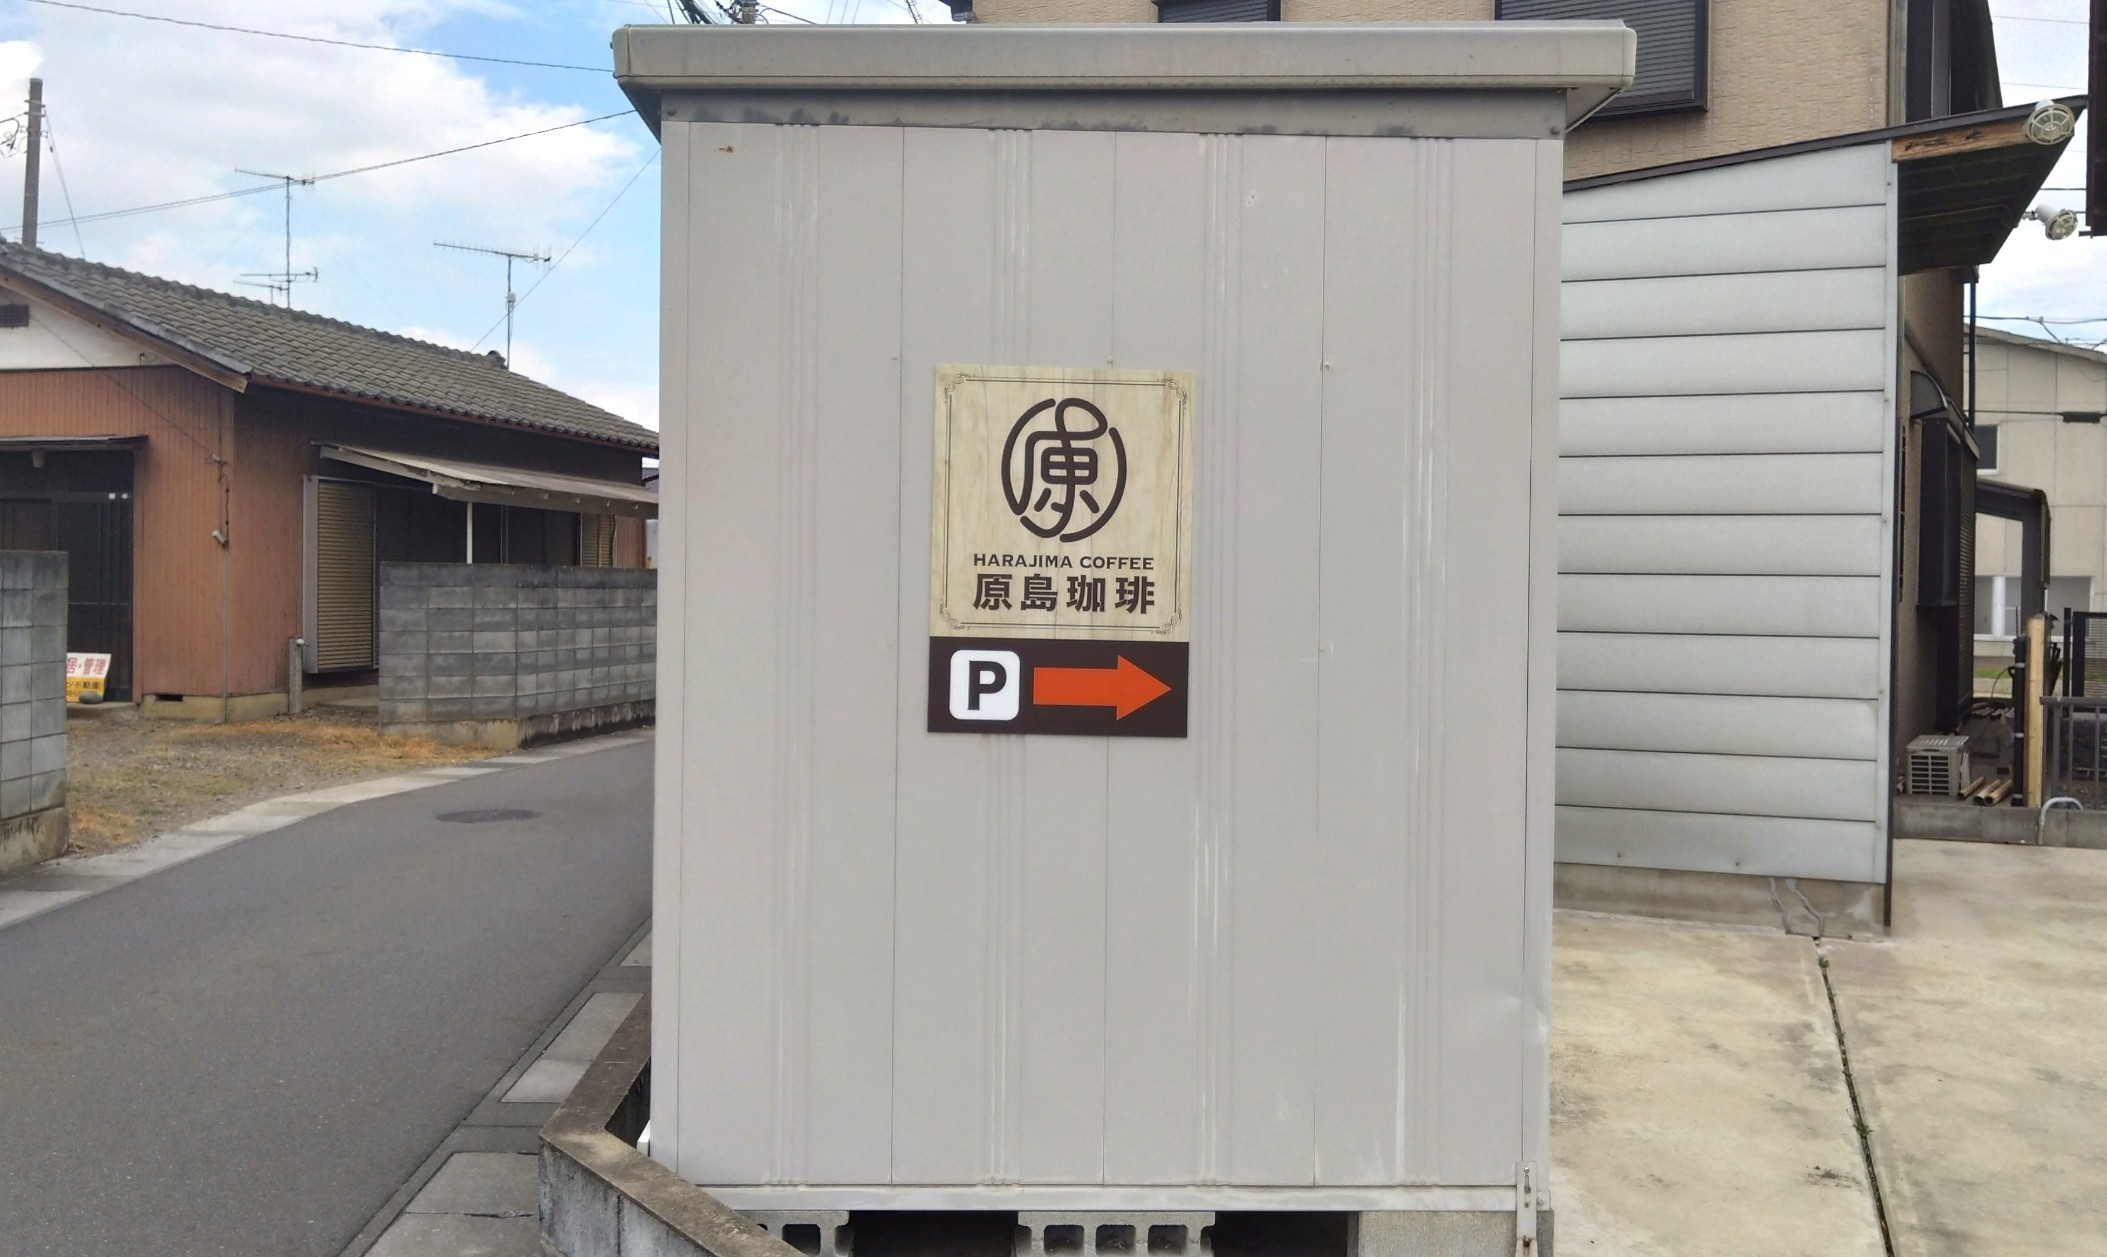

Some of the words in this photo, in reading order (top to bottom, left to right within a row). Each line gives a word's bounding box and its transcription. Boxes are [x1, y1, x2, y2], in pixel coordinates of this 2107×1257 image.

[973, 553, 1073, 569] HARAJIMA
[1079, 556, 1154, 570] COFFEE
[973, 573, 1155, 614] 原島珈琲
[967, 660, 1007, 711] P
